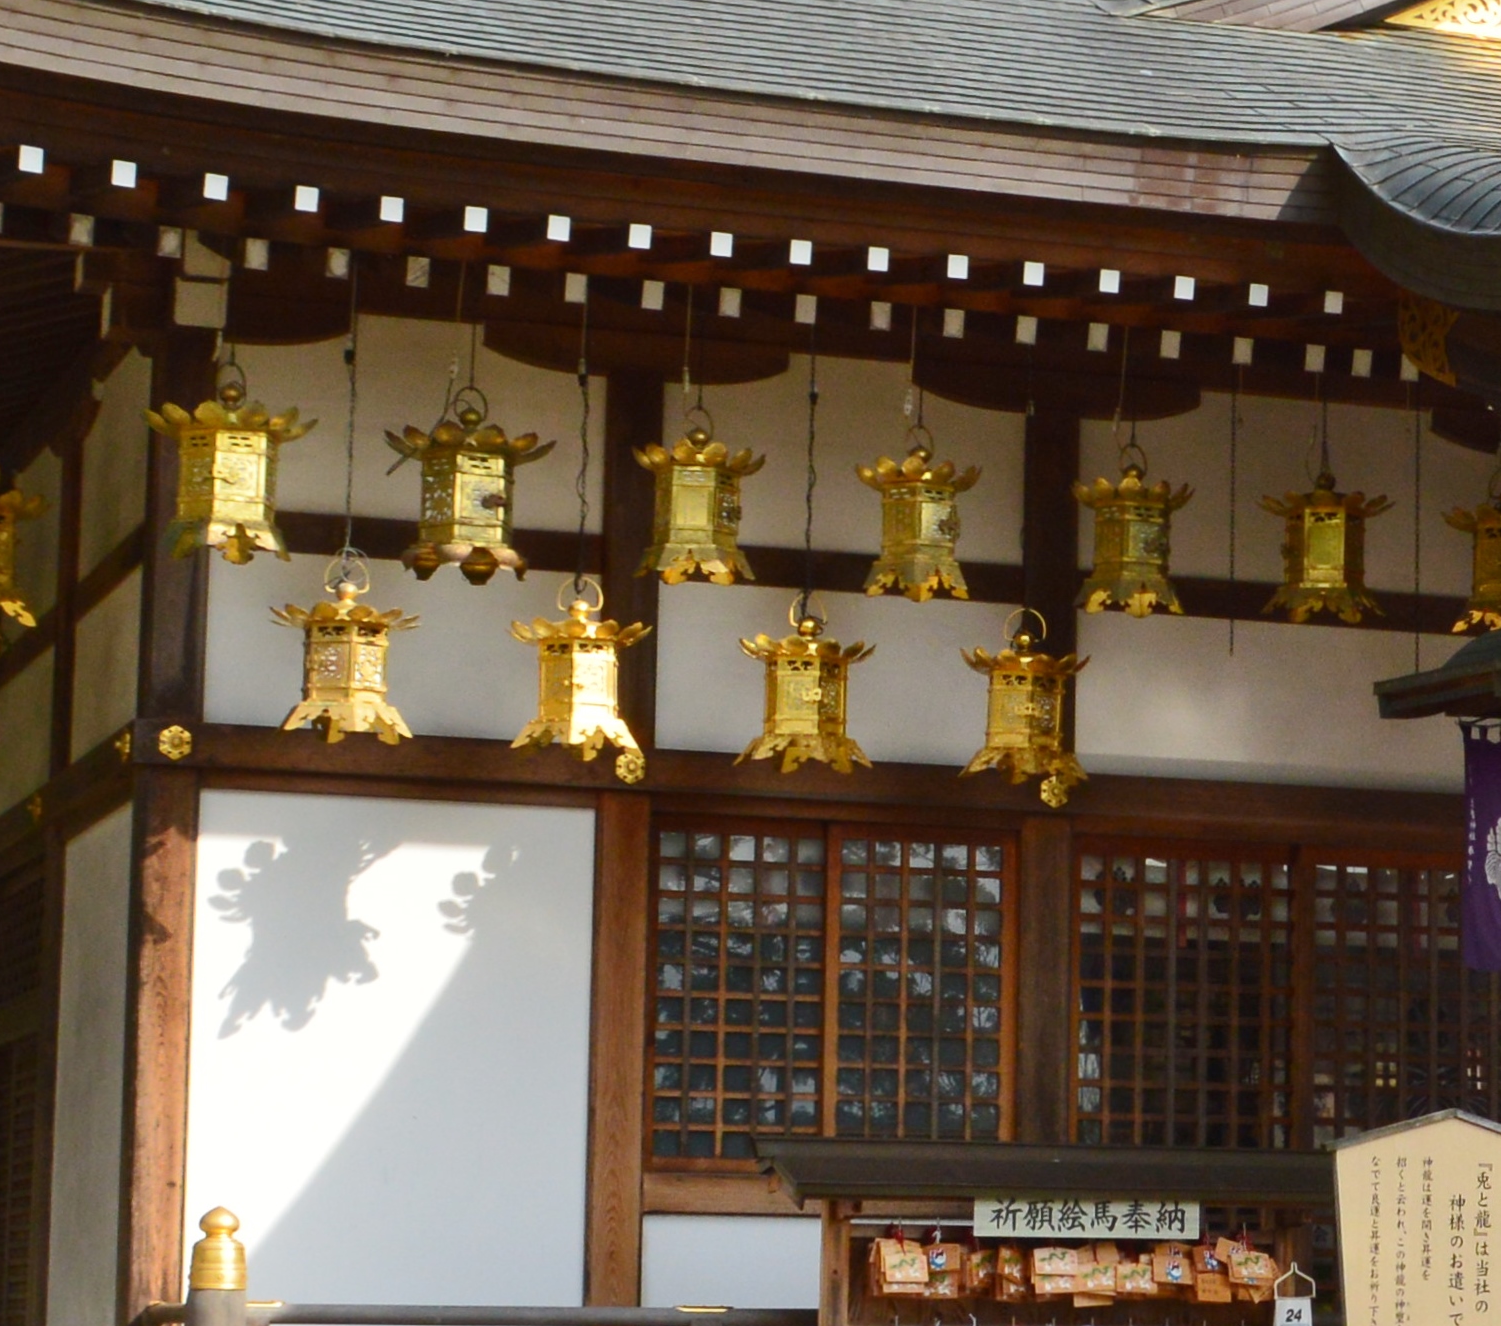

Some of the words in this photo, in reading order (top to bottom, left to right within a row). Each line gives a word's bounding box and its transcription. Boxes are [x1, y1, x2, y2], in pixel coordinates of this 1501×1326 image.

[990, 1198, 1186, 1233] 祈願絵馬奉納
[1473, 1162, 1493, 1313] 『兎と龍』は当社の
[1285, 1308, 1303, 1323] 24
